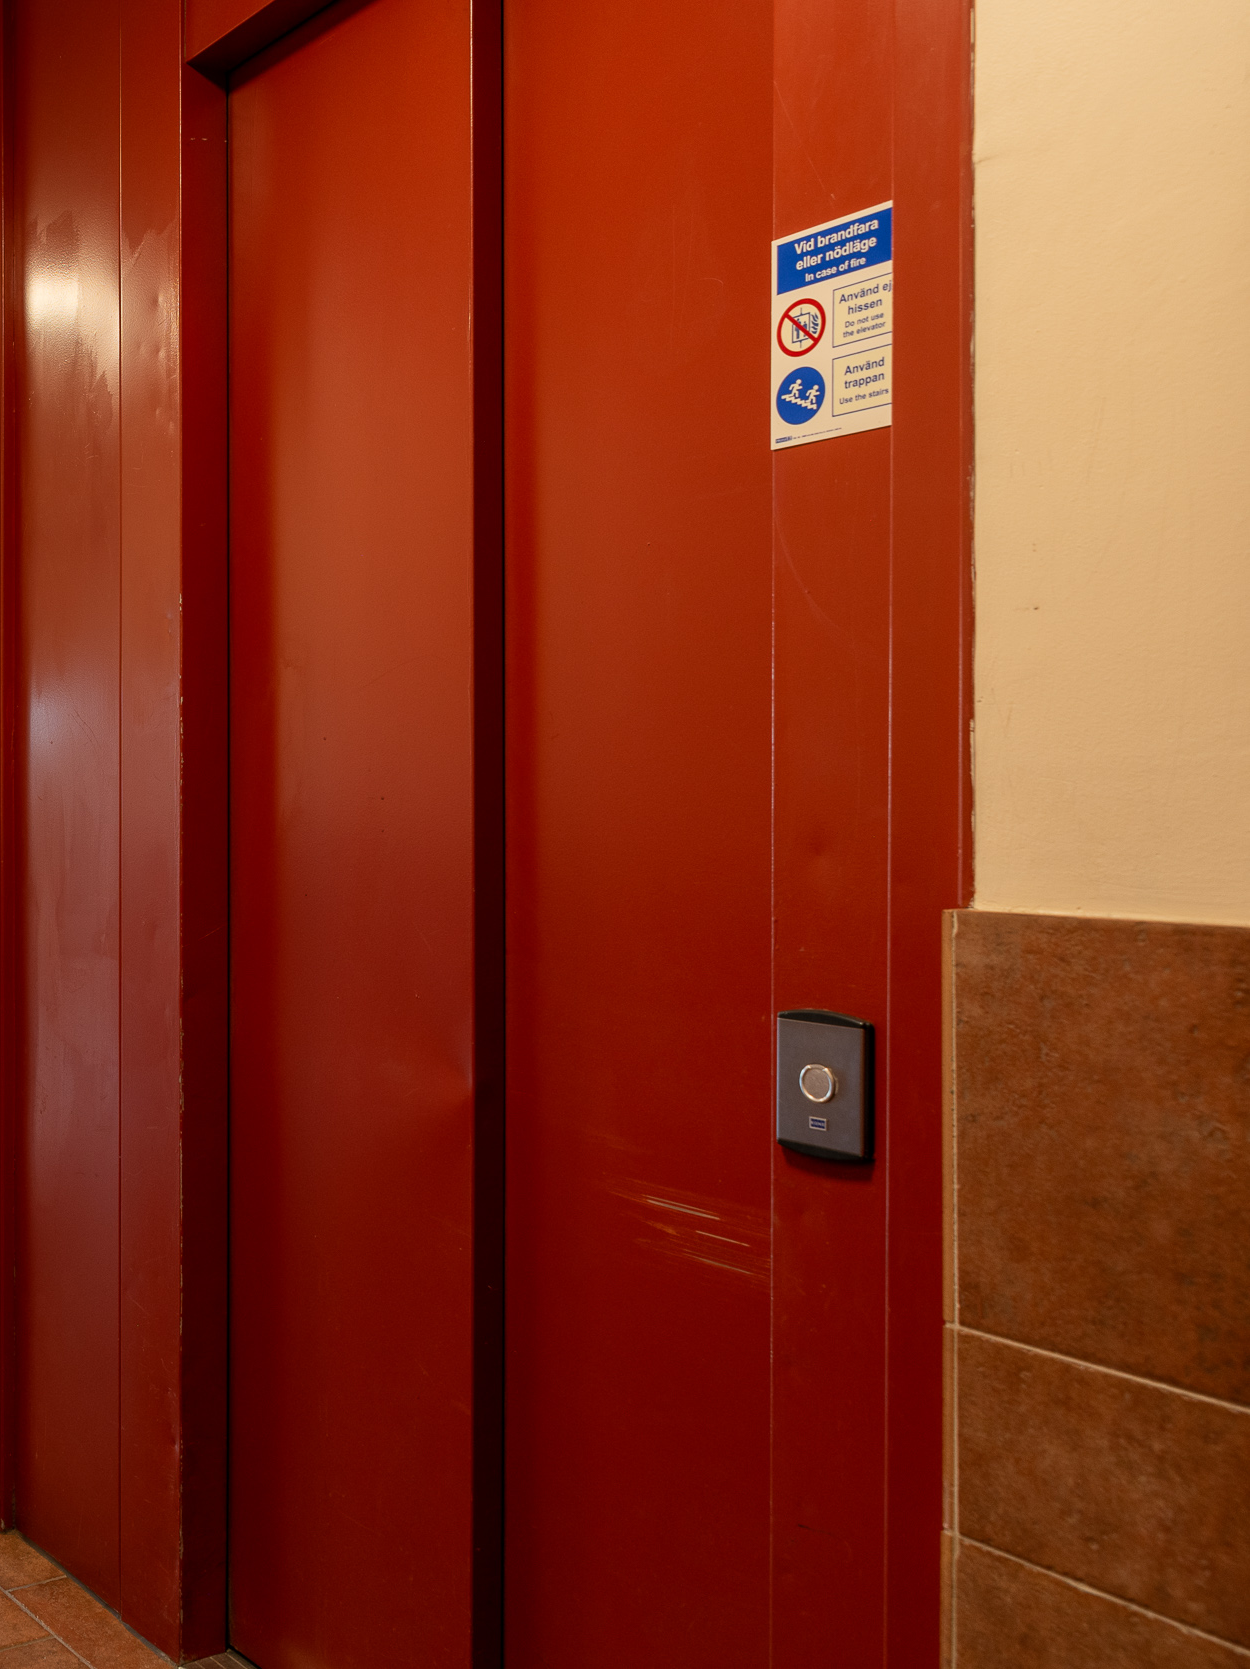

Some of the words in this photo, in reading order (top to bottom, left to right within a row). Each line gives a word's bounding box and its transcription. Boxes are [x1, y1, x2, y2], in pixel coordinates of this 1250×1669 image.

[794, 238, 814, 255] Vid
[817, 219, 879, 248] brandfara
[795, 253, 823, 270] eller
[825, 236, 877, 261] nödläge
[805, 273, 814, 282] In
[815, 266, 837, 279] case
[838, 260, 849, 271] of
[849, 257, 867, 268] fire
[839, 283, 879, 304] Använd
[882, 279, 892, 292] ej
[847, 298, 883, 315] hissen
[845, 320, 855, 328] Do
[857, 316, 869, 325] not
[871, 312, 884, 321] use
[843, 330, 854, 338] the
[856, 321, 886, 334] elevator
[844, 356, 885, 376] Använd
[844, 373, 885, 389] trappan
[839, 397, 853, 405] Use
[855, 393, 867, 401] the
[868, 388, 889, 398] stairs
